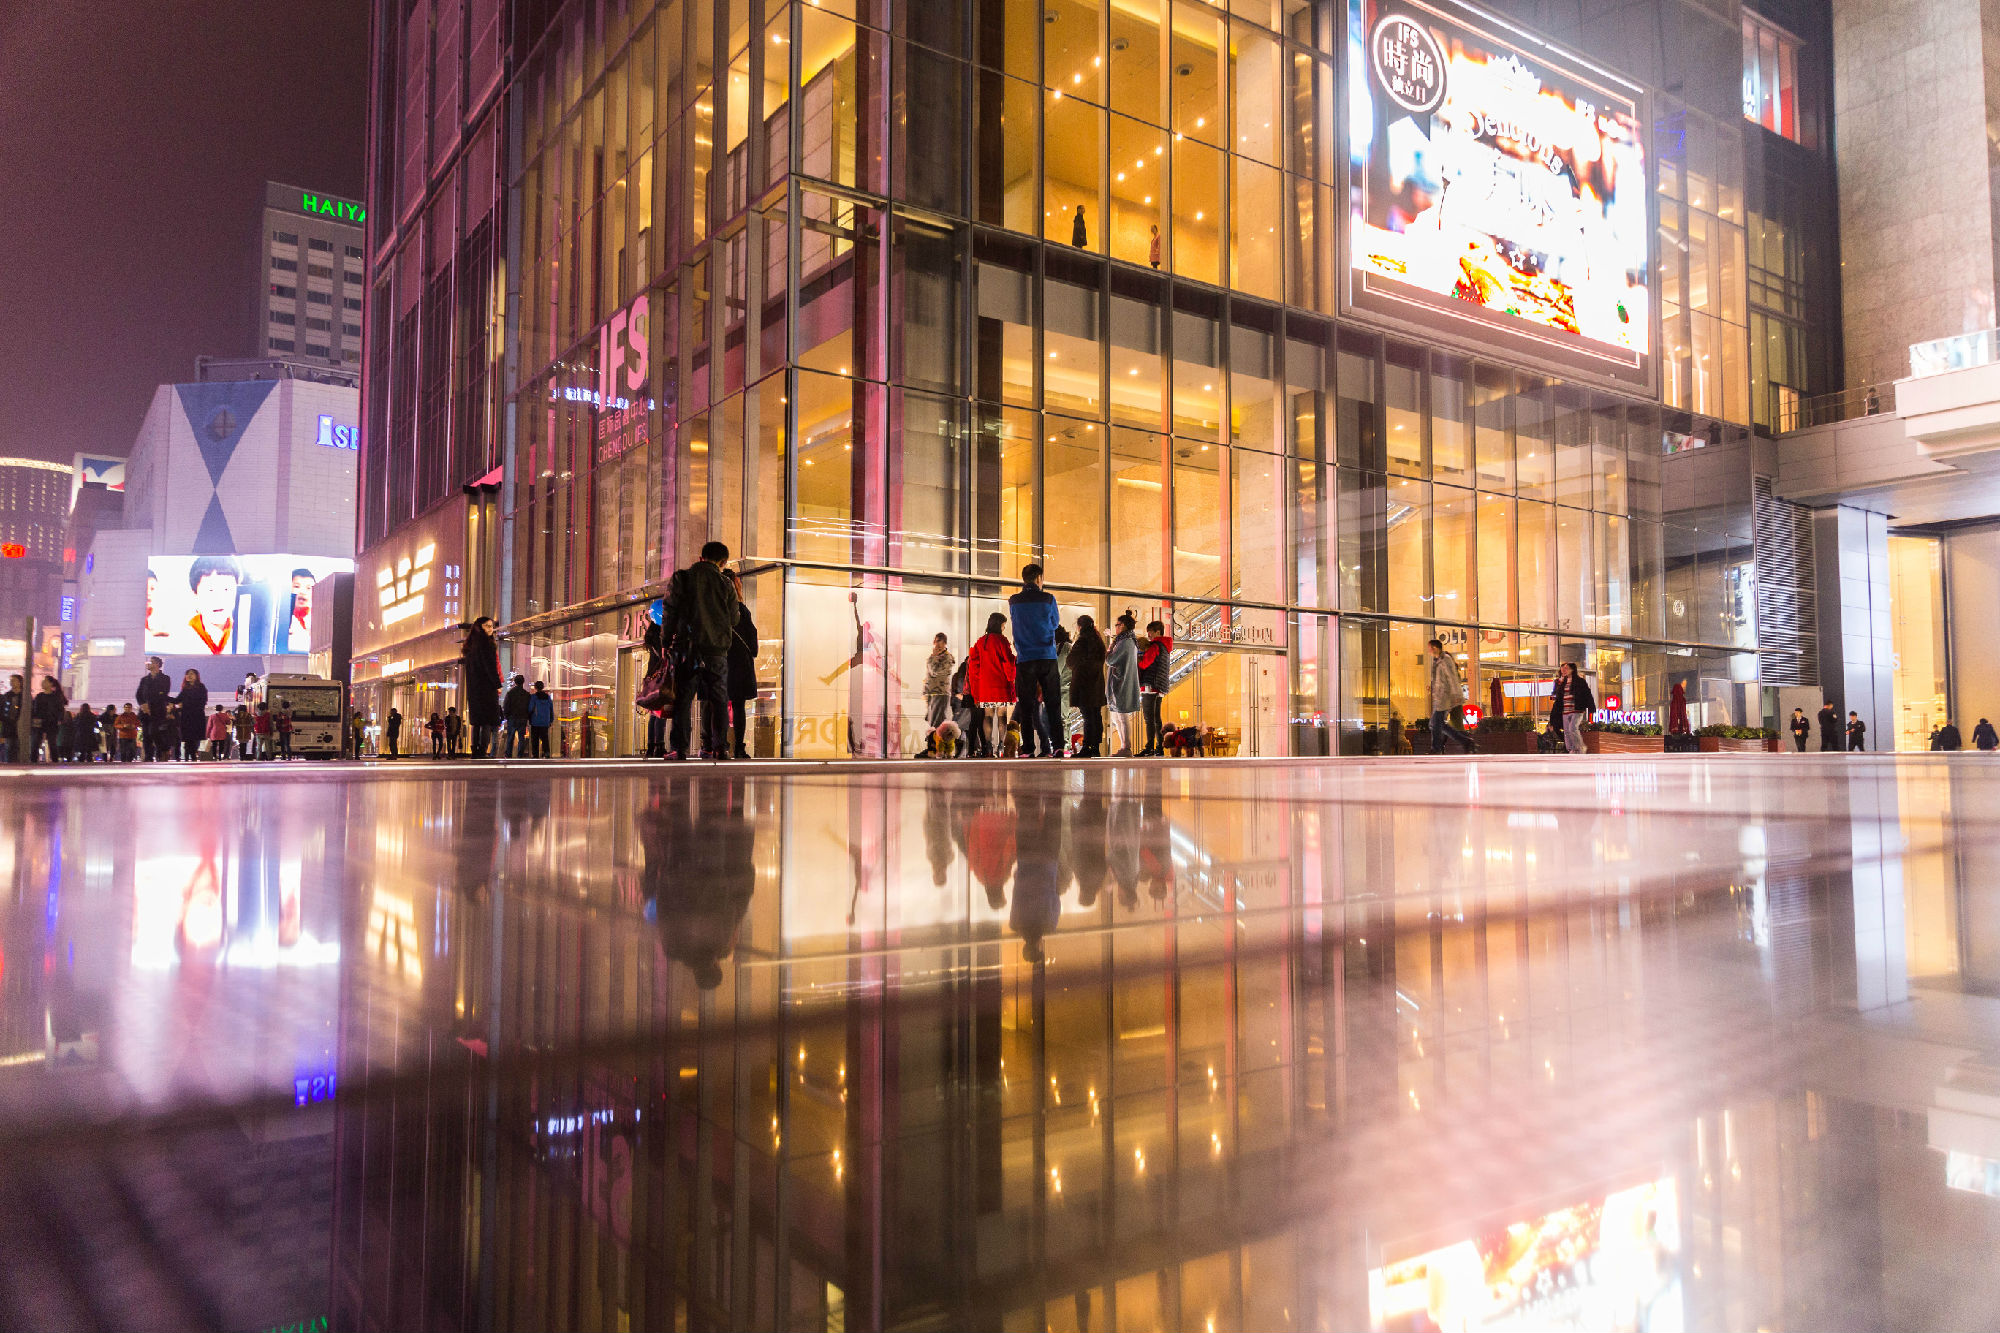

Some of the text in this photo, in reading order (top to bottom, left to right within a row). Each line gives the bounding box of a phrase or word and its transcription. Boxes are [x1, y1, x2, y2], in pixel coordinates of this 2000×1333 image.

[1398, 22, 1419, 48] IFS
[599, 295, 648, 414] IFS
[623, 613, 631, 641] 2
[1624, 710, 1656, 726] COFFEE
